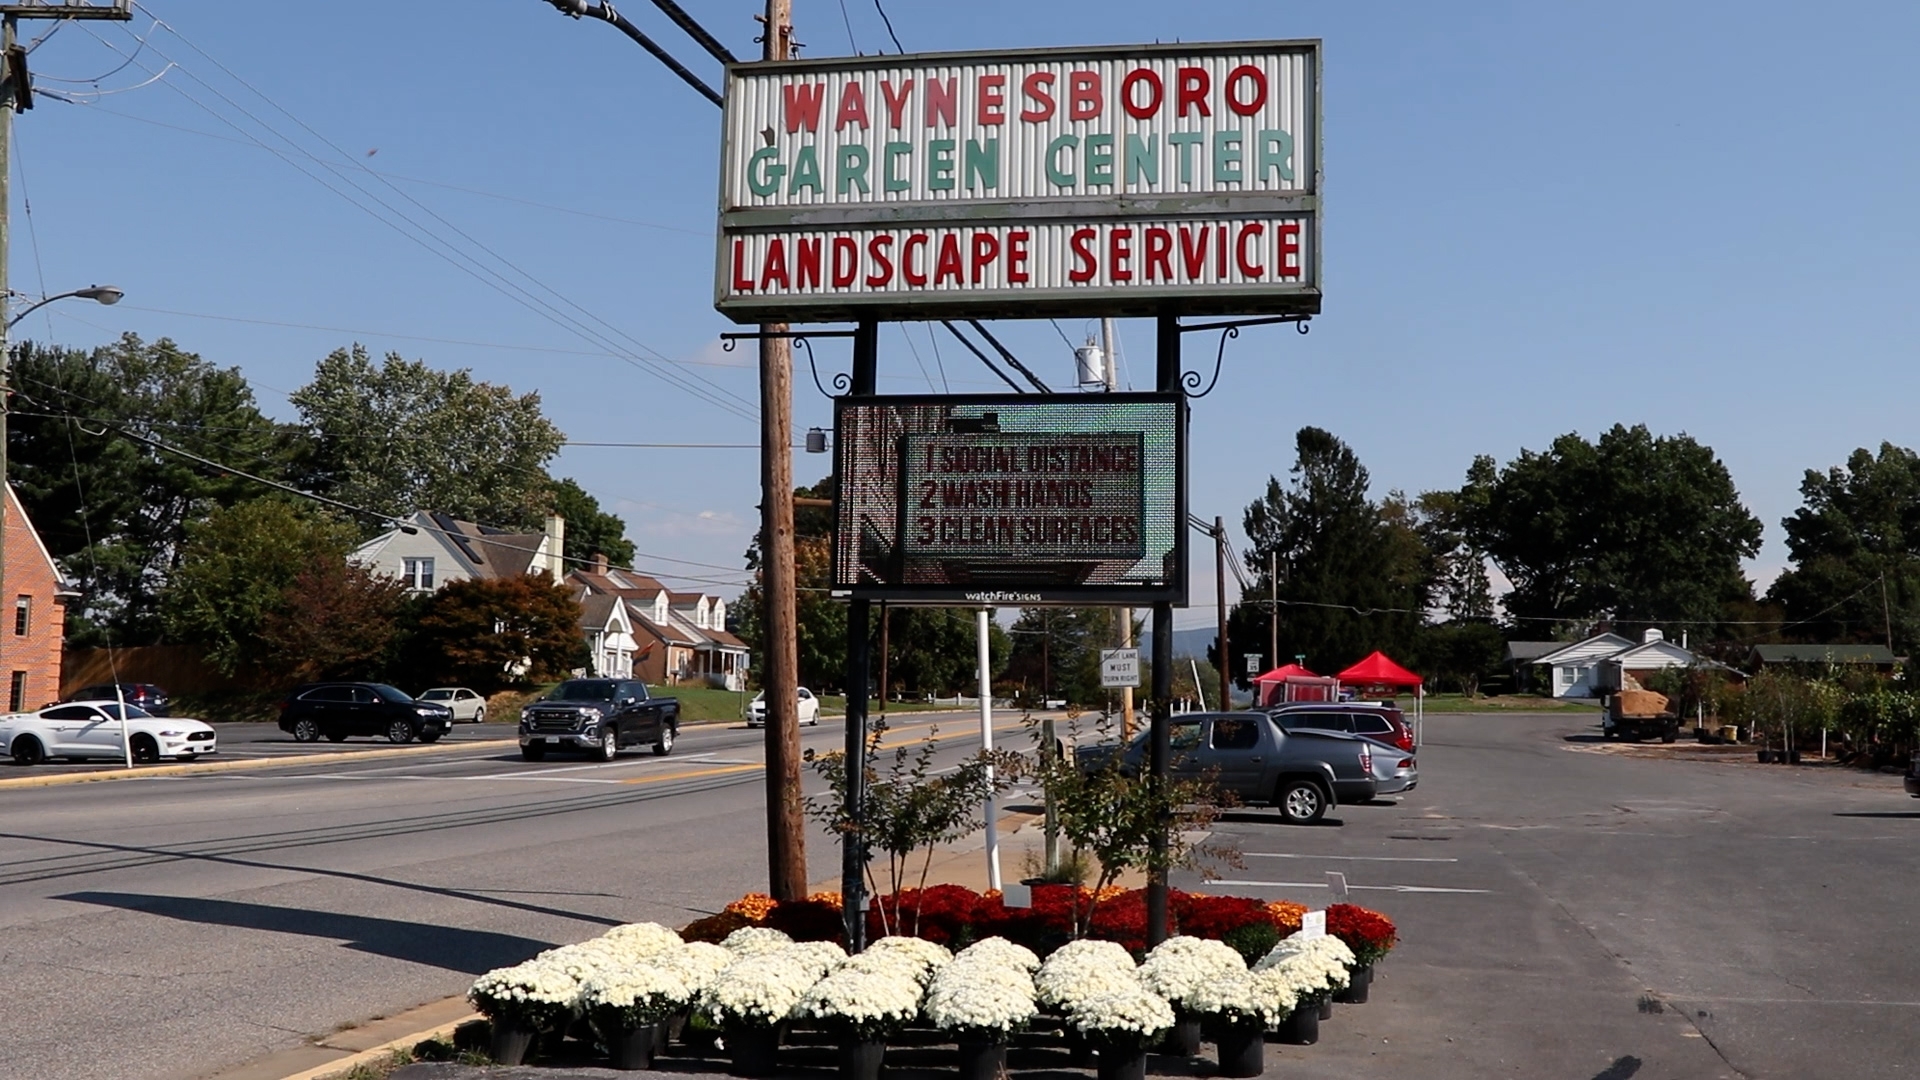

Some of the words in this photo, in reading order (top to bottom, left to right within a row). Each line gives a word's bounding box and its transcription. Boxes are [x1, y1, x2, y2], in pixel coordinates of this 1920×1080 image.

[782, 65, 1267, 133] WAYNESBORO
[1046, 129, 1294, 187] CENTER
[733, 231, 1029, 290] LANDSCAPE
[1069, 223, 1300, 282] SERVICE
[942, 446, 1023, 472] SOCIAL
[1027, 446, 1138, 472] DISTANCE
[920, 480, 937, 509] 2
[942, 480, 1009, 508] WASH
[1014, 480, 1093, 508] HANDS
[917, 516, 936, 545] 3
[941, 516, 1014, 544] CLEAN
[1018, 516, 1139, 544] SURFACES
